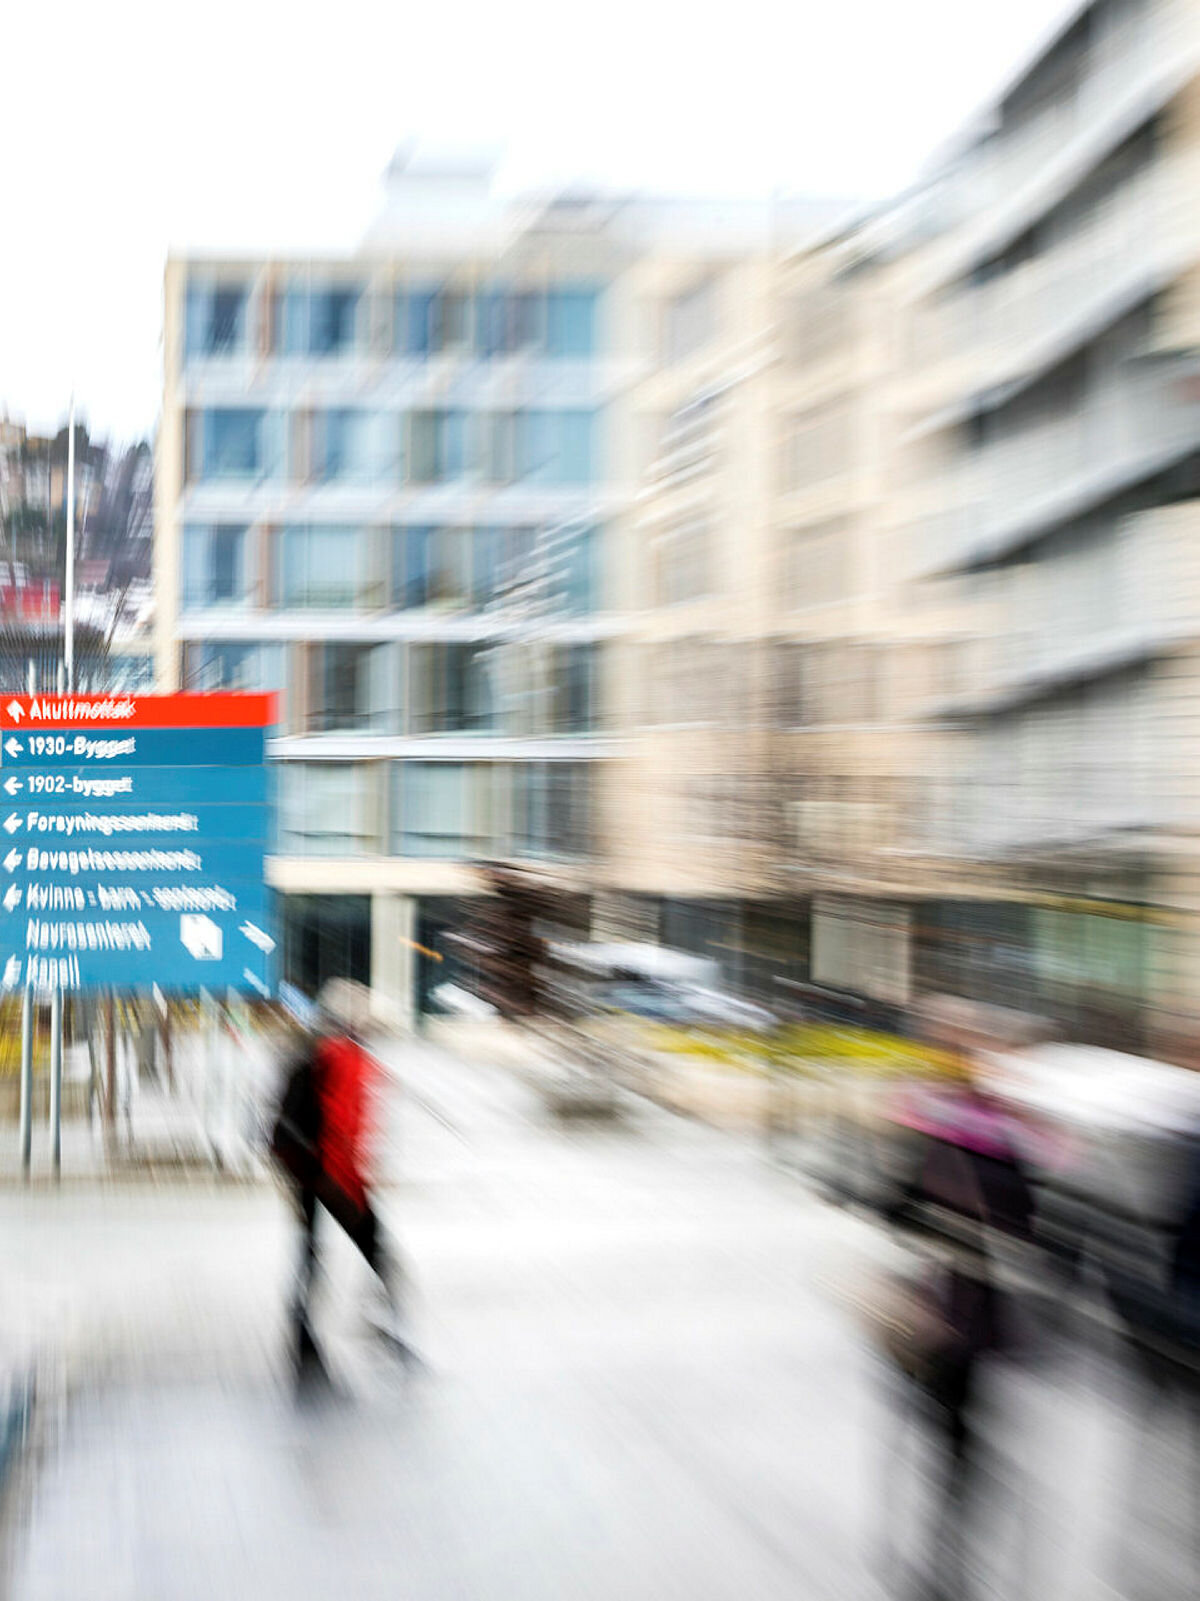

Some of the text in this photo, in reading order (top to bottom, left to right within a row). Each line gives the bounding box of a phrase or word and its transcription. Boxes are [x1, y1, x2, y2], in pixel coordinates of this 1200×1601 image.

[28, 736, 136, 758] 1930-Bygget
[27, 776, 133, 796] 1902-bygget
[27, 883, 85, 911] Kvinne
